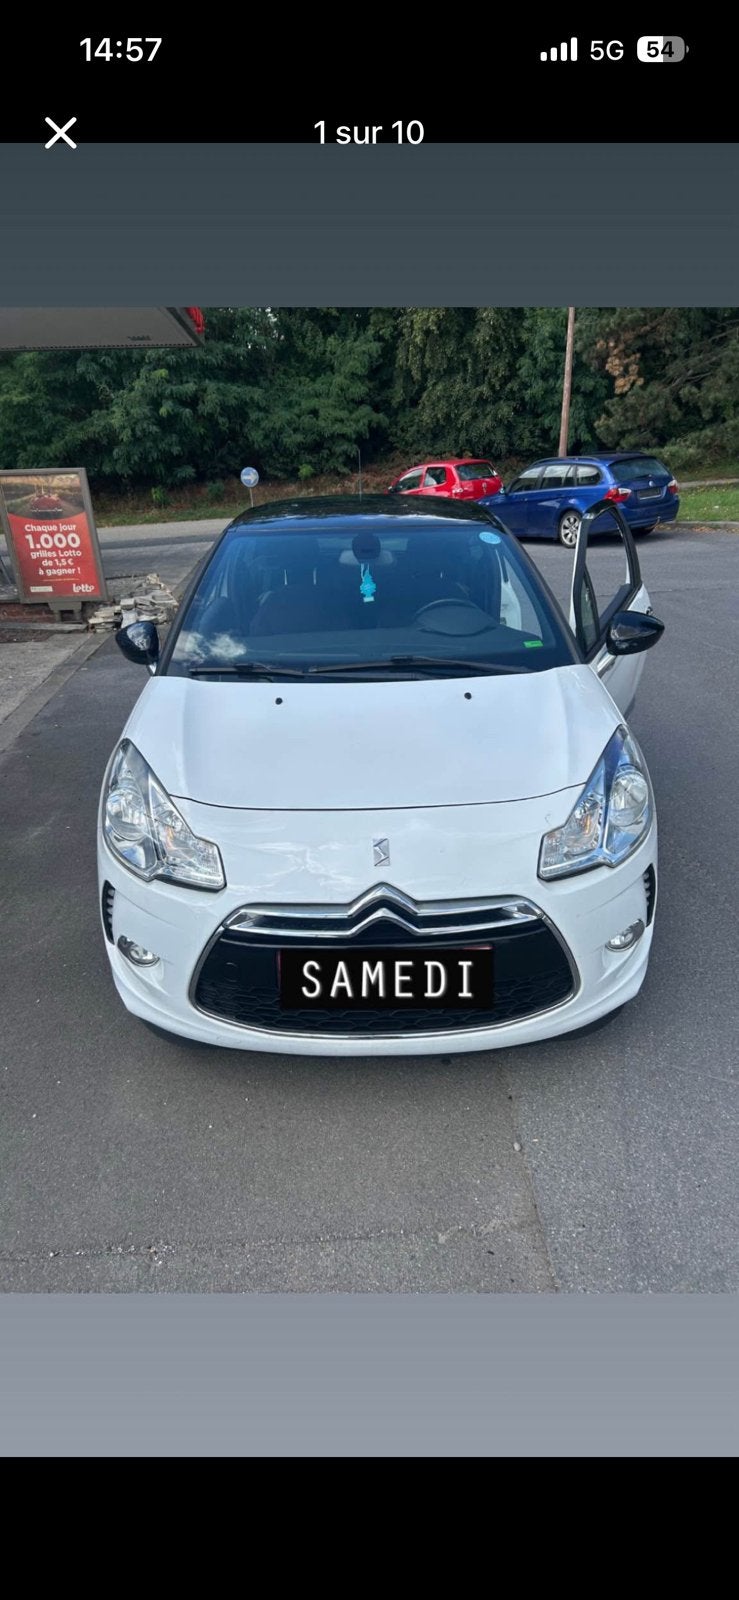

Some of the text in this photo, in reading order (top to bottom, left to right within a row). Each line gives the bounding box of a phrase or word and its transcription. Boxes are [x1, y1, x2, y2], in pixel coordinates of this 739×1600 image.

[24, 523, 77, 532] Chaque jour
[25, 533, 81, 549] 1.000
[30, 549, 82, 559] grilles Lotto
[54, 559, 67, 567] 1,5
[38, 567, 44, 575] à
[45, 568, 76, 576] gagner
[72, 583, 95, 592] Lotto
